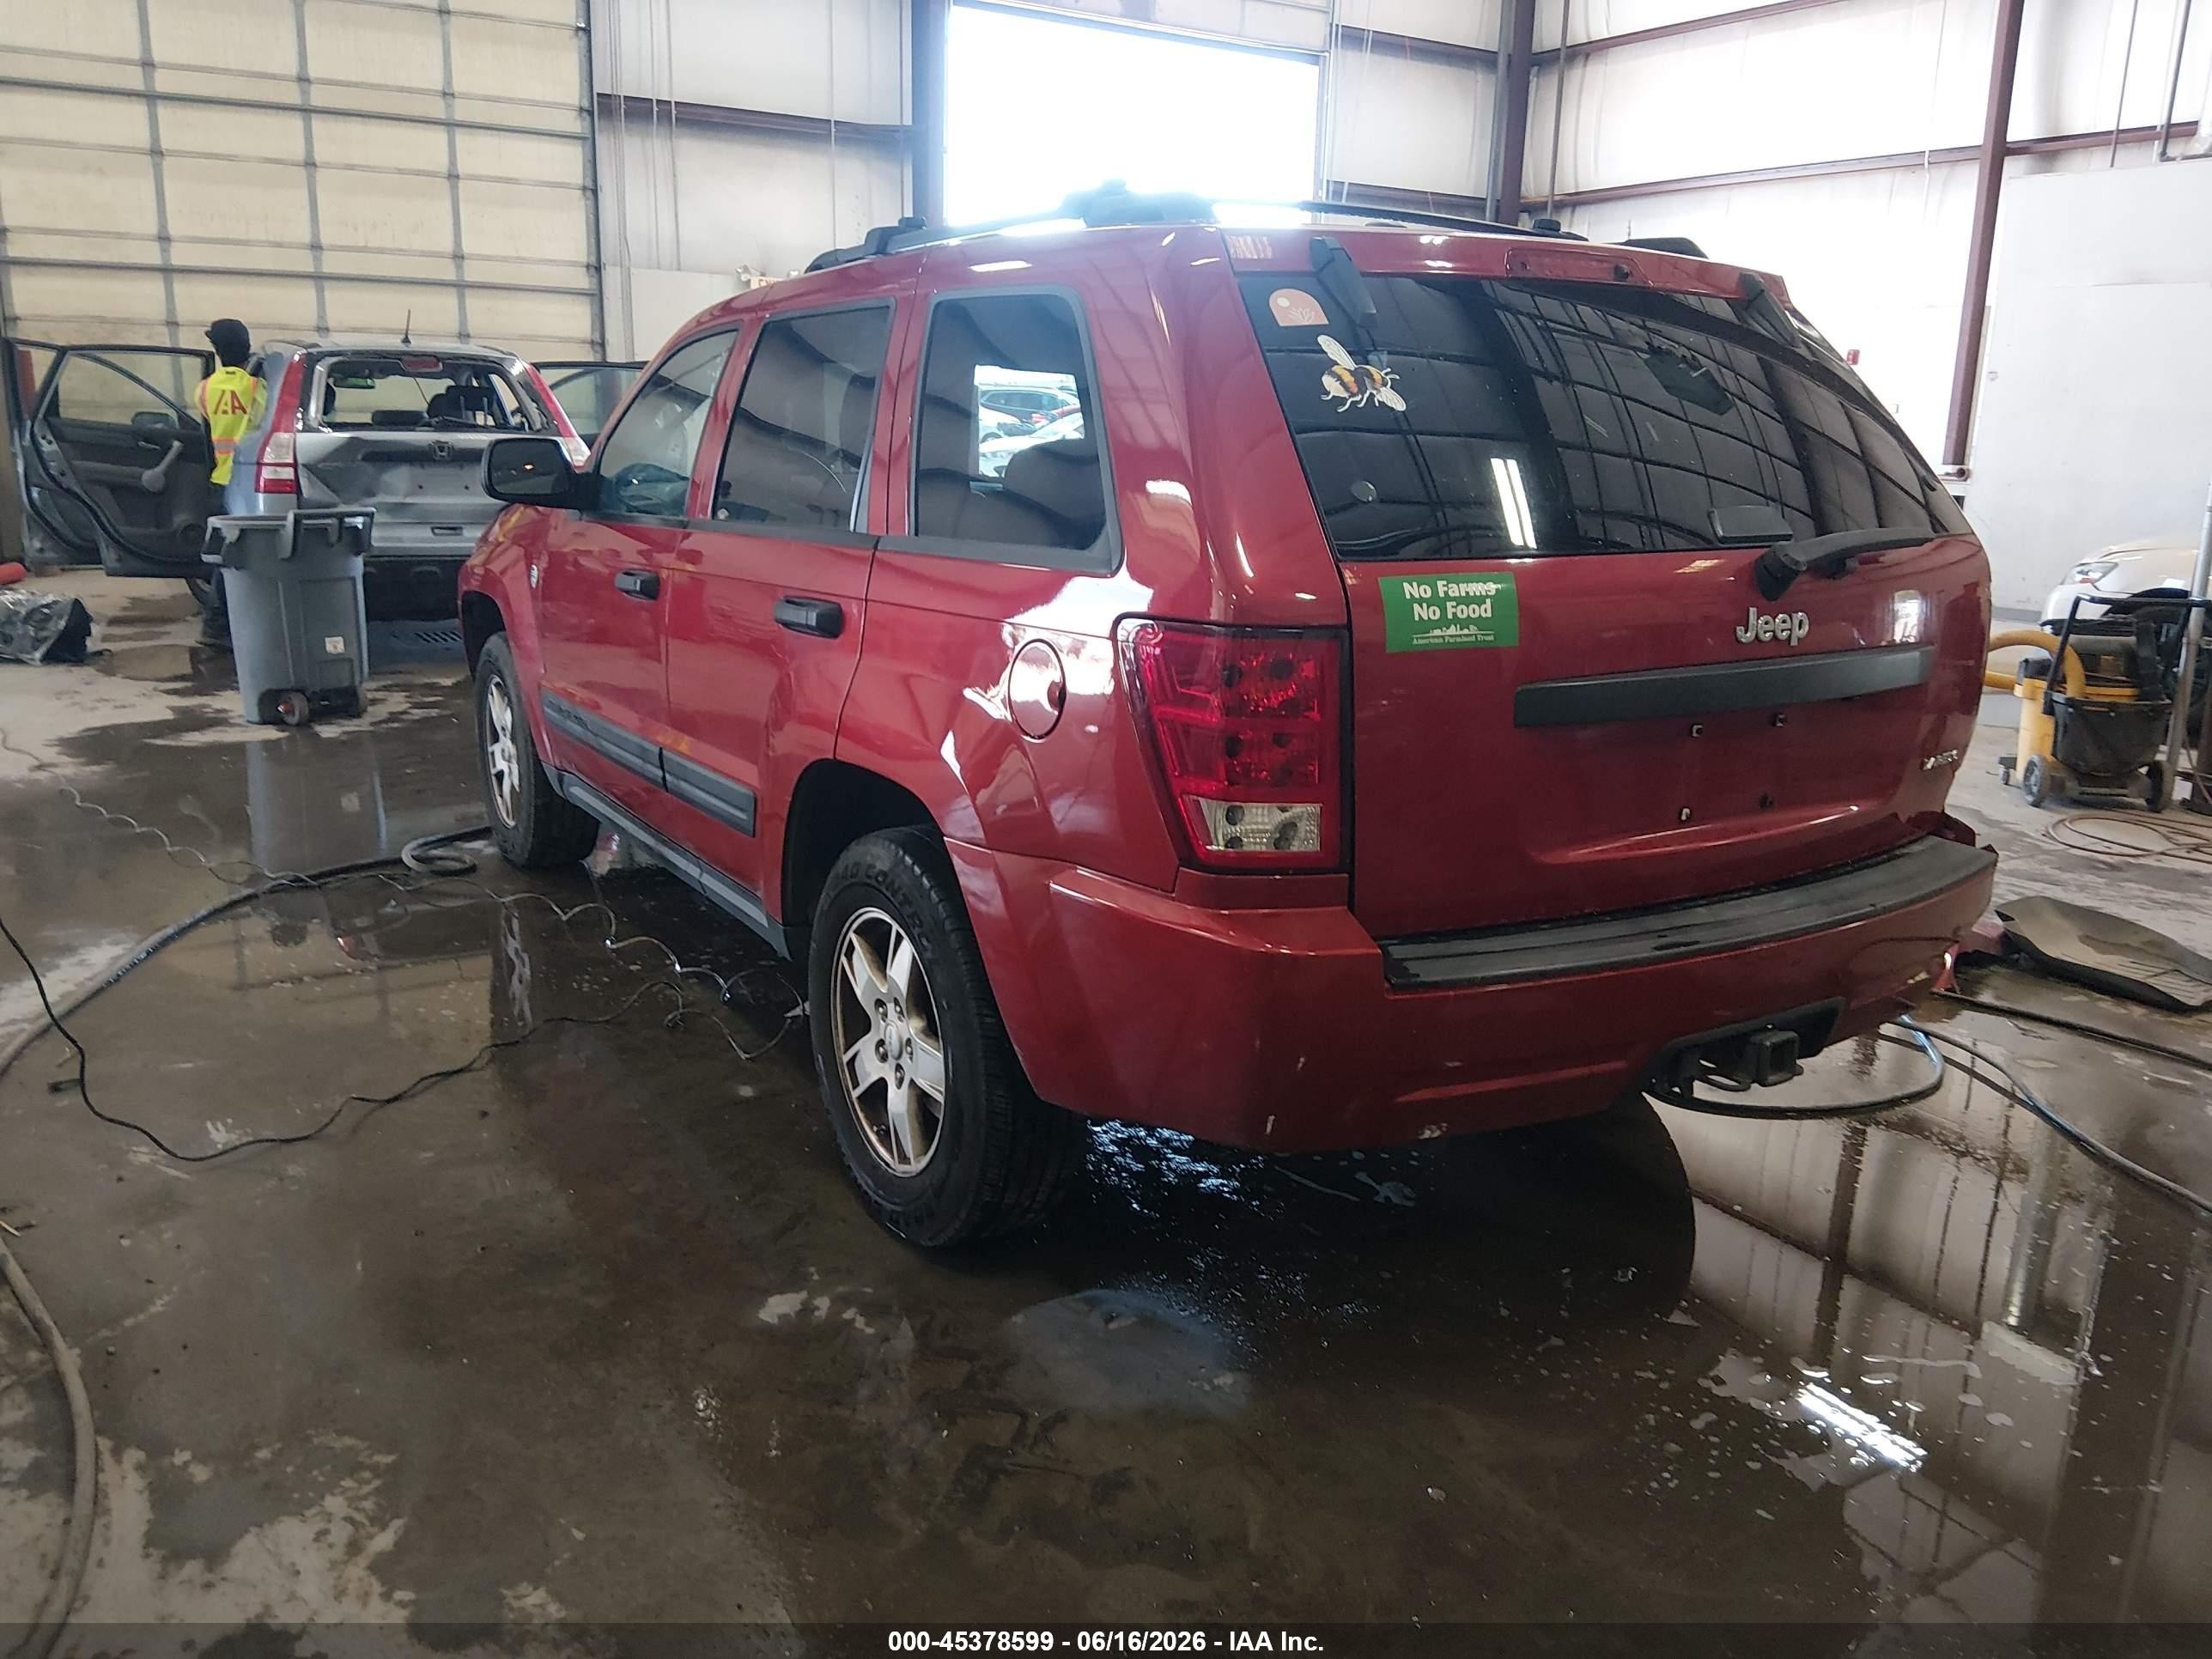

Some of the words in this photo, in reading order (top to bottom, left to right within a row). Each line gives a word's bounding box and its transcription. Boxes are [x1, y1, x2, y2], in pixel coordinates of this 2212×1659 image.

[1403, 581, 1432, 599] No
[1437, 580, 1497, 598] Farms
[1413, 603, 1441, 621] No
[1446, 599, 1492, 619] Food
[1735, 606, 1809, 646] Jeep
